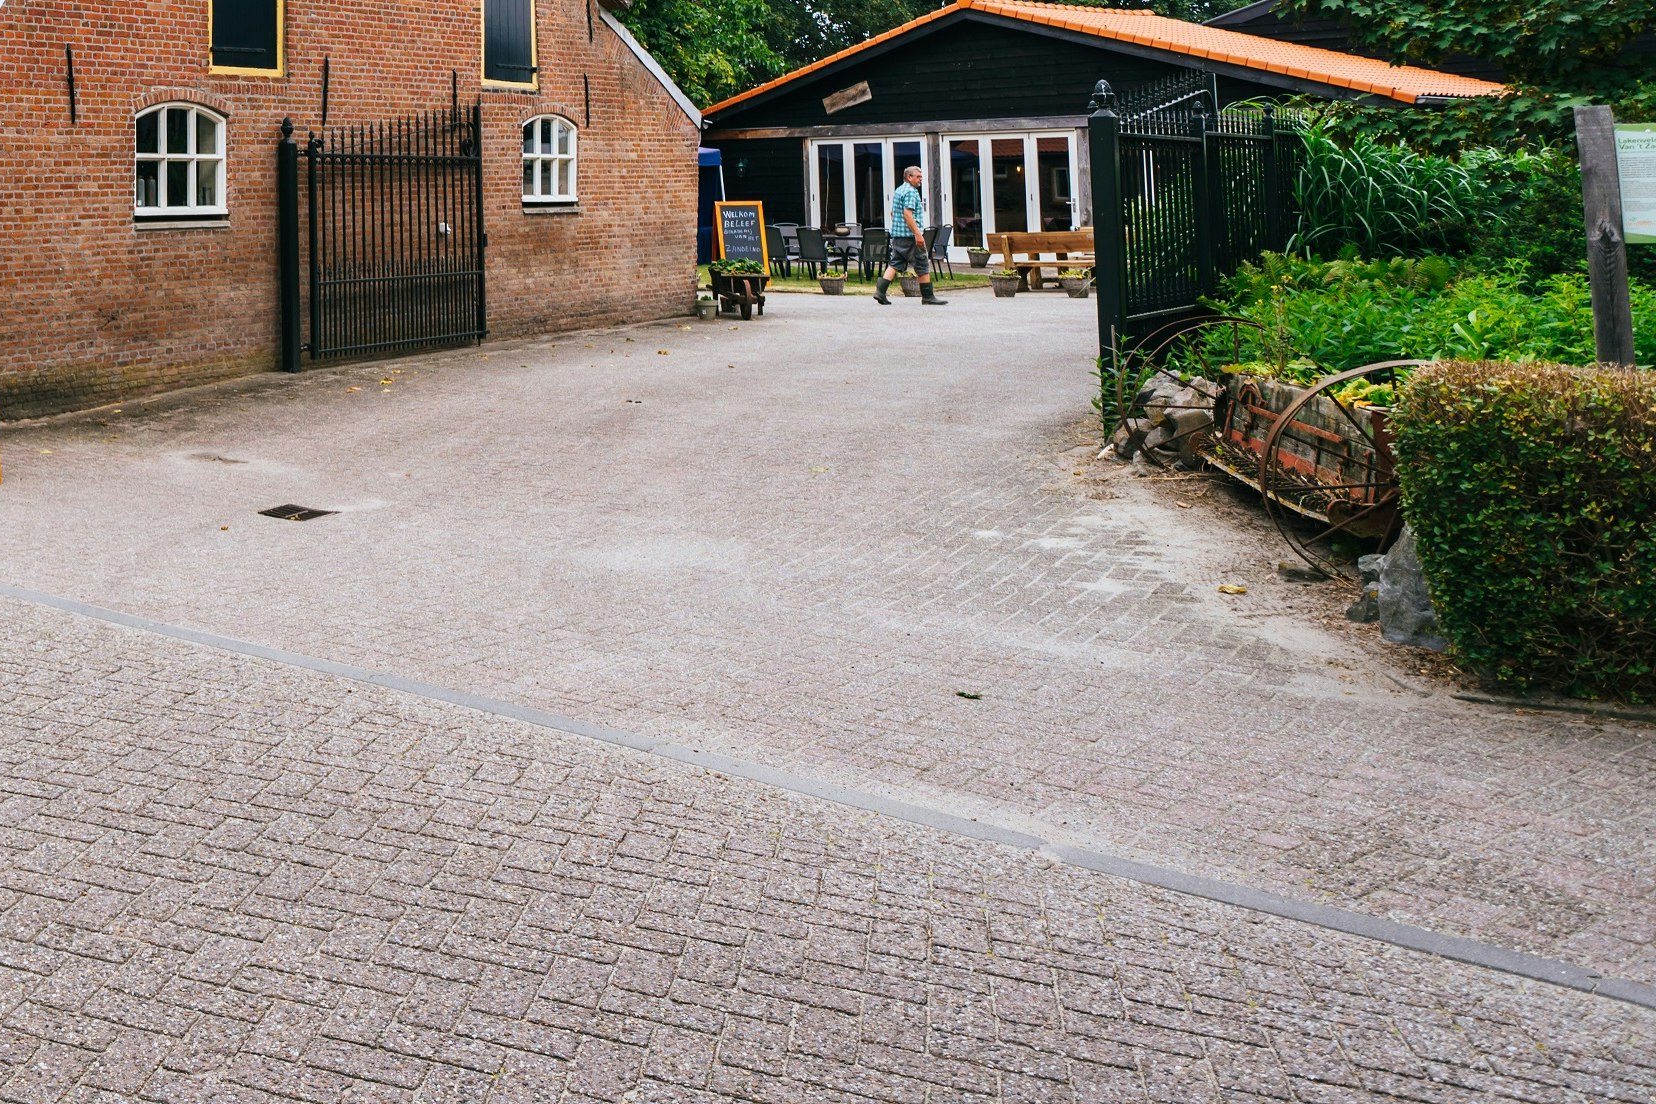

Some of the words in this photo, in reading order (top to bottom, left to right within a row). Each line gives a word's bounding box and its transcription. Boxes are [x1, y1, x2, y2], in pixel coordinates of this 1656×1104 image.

[723, 211, 755, 219] WELKOM
[724, 220, 756, 228] BELEEF
[725, 244, 761, 253] ZANDEIND
